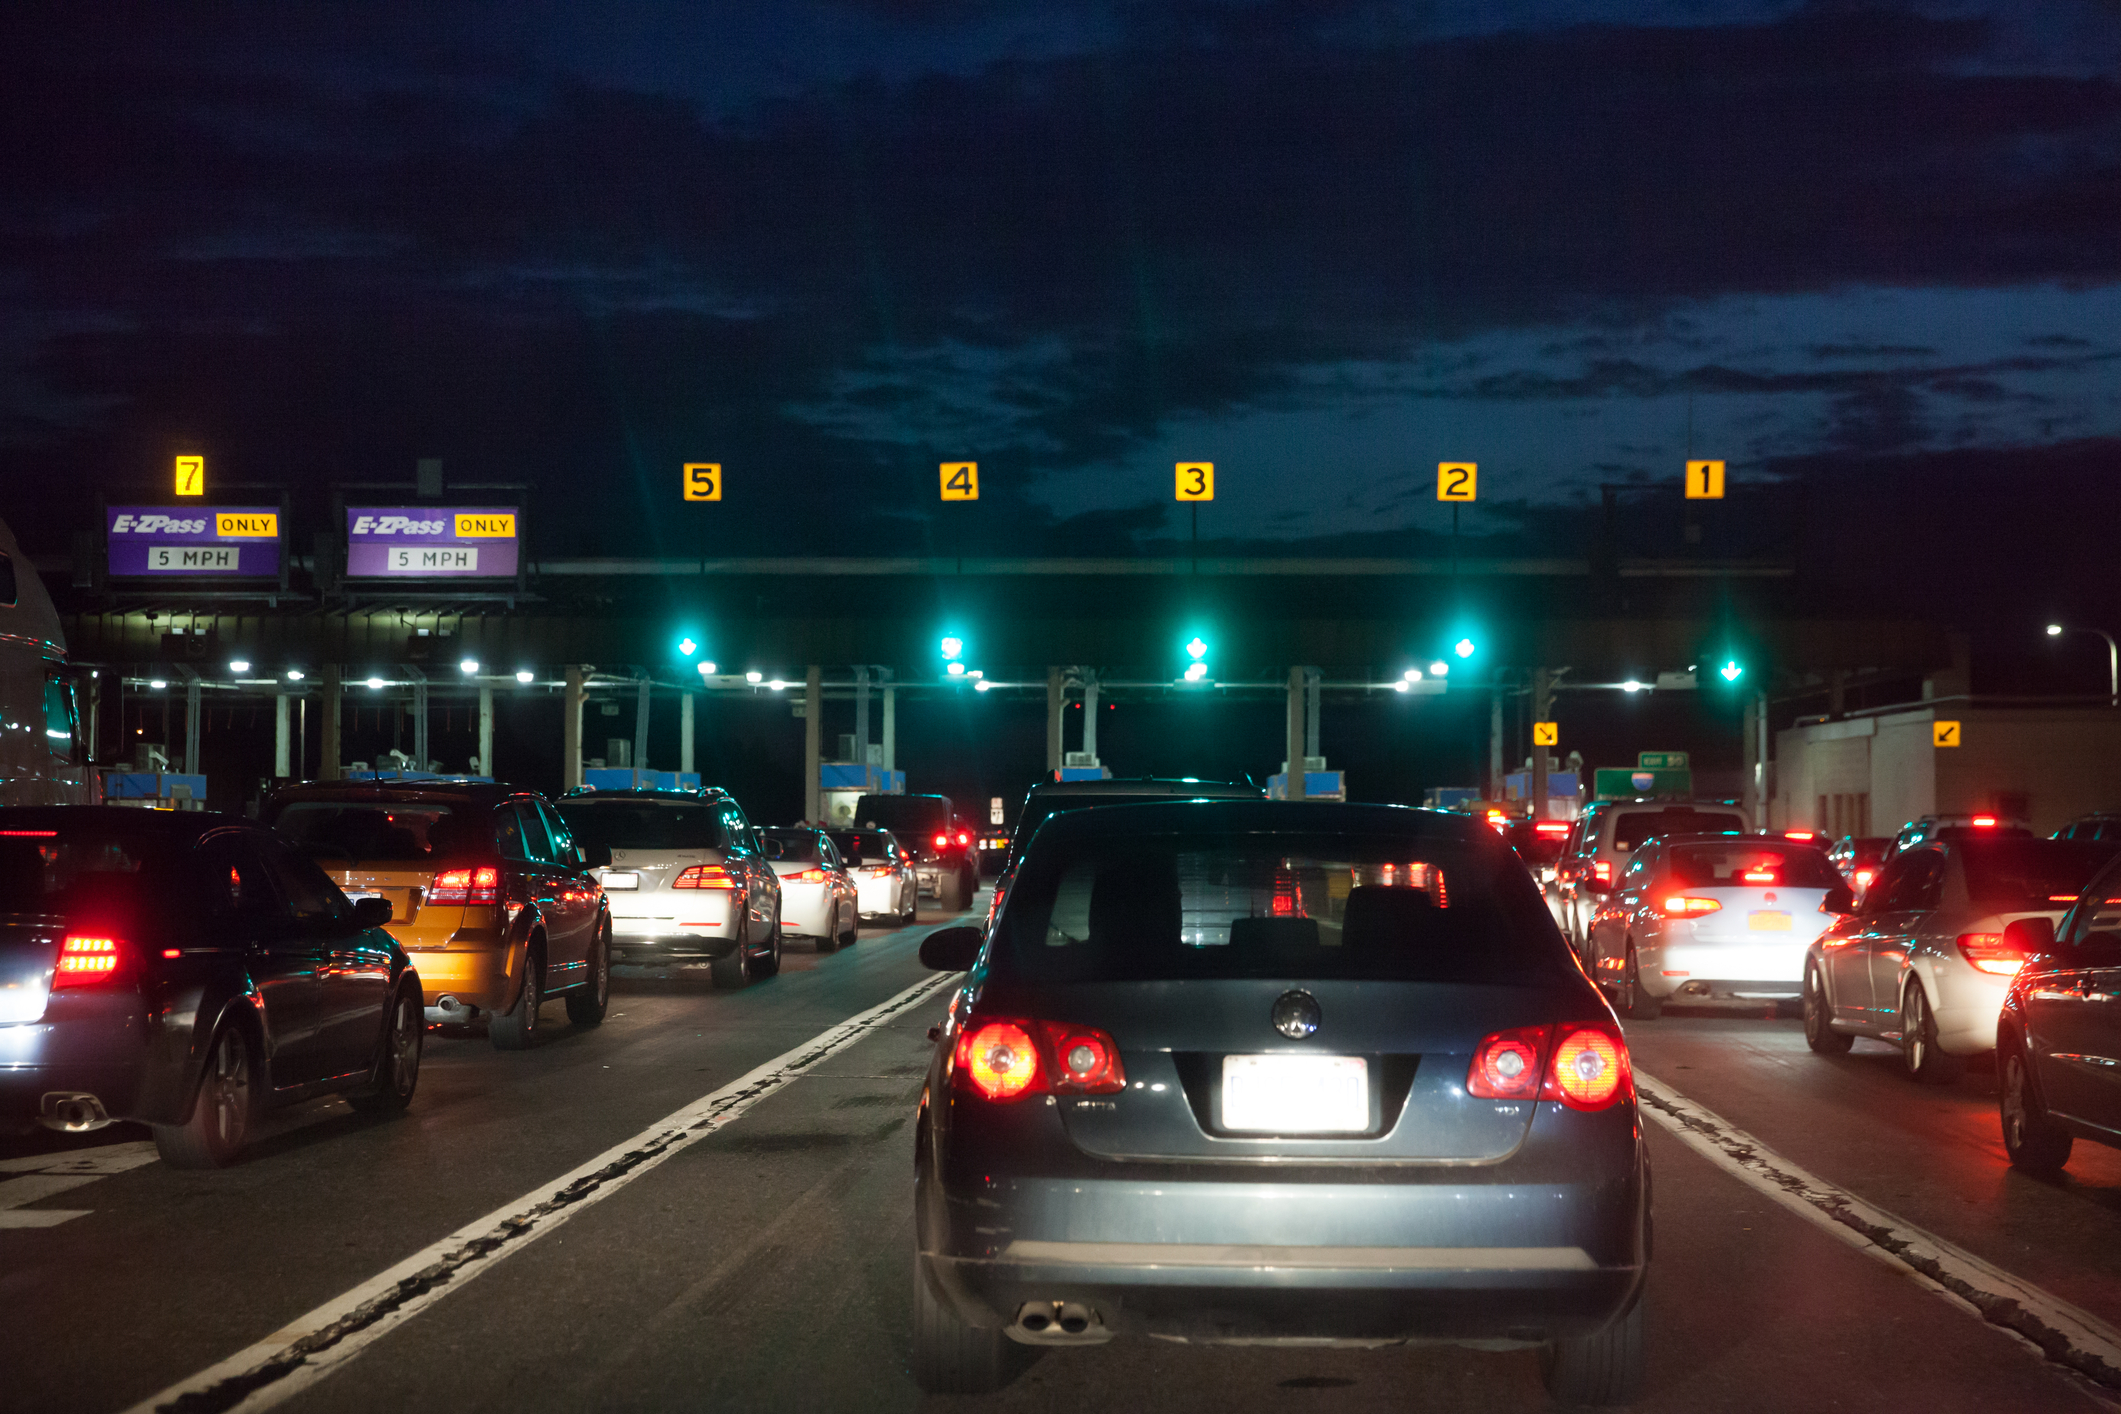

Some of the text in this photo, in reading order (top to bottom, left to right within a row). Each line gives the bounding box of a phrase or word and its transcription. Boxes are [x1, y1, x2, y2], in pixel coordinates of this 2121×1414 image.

[180, 462, 199, 490] 7
[691, 467, 714, 497] 5
[946, 466, 973, 495] 4
[1184, 467, 1206, 495] 3
[1446, 468, 1469, 496] 2
[1701, 465, 1710, 493] 1
[112, 514, 270, 534] E-ZPass ONLY
[352, 516, 509, 535] E-ZPass ONLY
[159, 551, 229, 566] 5 MPH
[399, 552, 468, 567] 5 MPH
